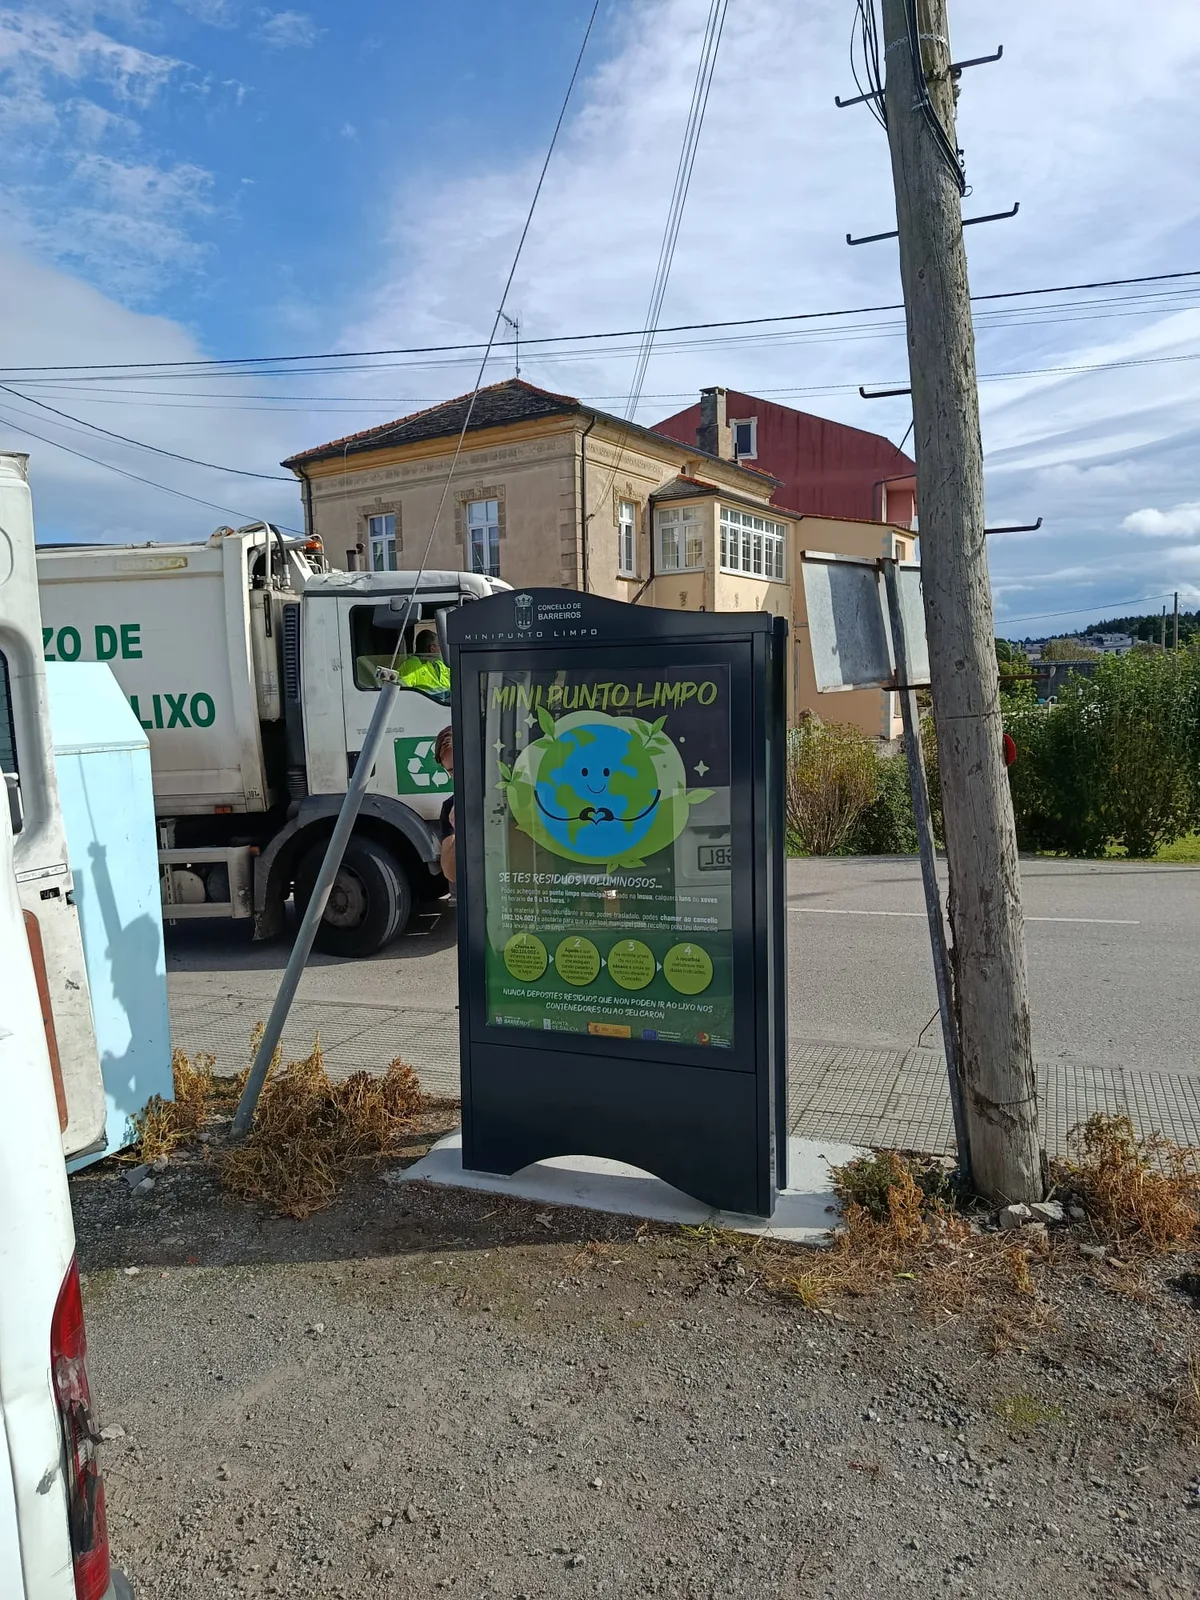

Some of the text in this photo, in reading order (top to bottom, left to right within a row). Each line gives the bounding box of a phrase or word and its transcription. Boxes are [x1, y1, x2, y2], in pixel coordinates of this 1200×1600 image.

[537, 602, 582, 612] CONCELLO DE
[537, 611, 582, 621] BARREIROS
[464, 628, 598, 640] MINIPUNTO LIMPO
[94, 624, 143, 661] DE
[490, 681, 718, 713] MINI PUNTO LIMPO
[130, 692, 216, 729] LIXO
[498, 872, 663, 888] SE TES RESIDUOS VOLUMINOSOS...
[549, 890, 564, 898] punto
[565, 890, 580, 898] limpo
[660, 914, 682, 922] chamar
[693, 916, 718, 924] concello
[522, 935, 526, 944] 1
[574, 938, 580, 948] 2
[628, 942, 634, 951] 3
[684, 945, 692, 956] 4
[502, 988, 714, 1014] NUNCA DEPOSITES RESIDUOS QUE NON PODEN IR AO LIXO NOS
[546, 1002, 601, 1014] CONTENEDORES
[624, 1008, 640, 1017] SEU
